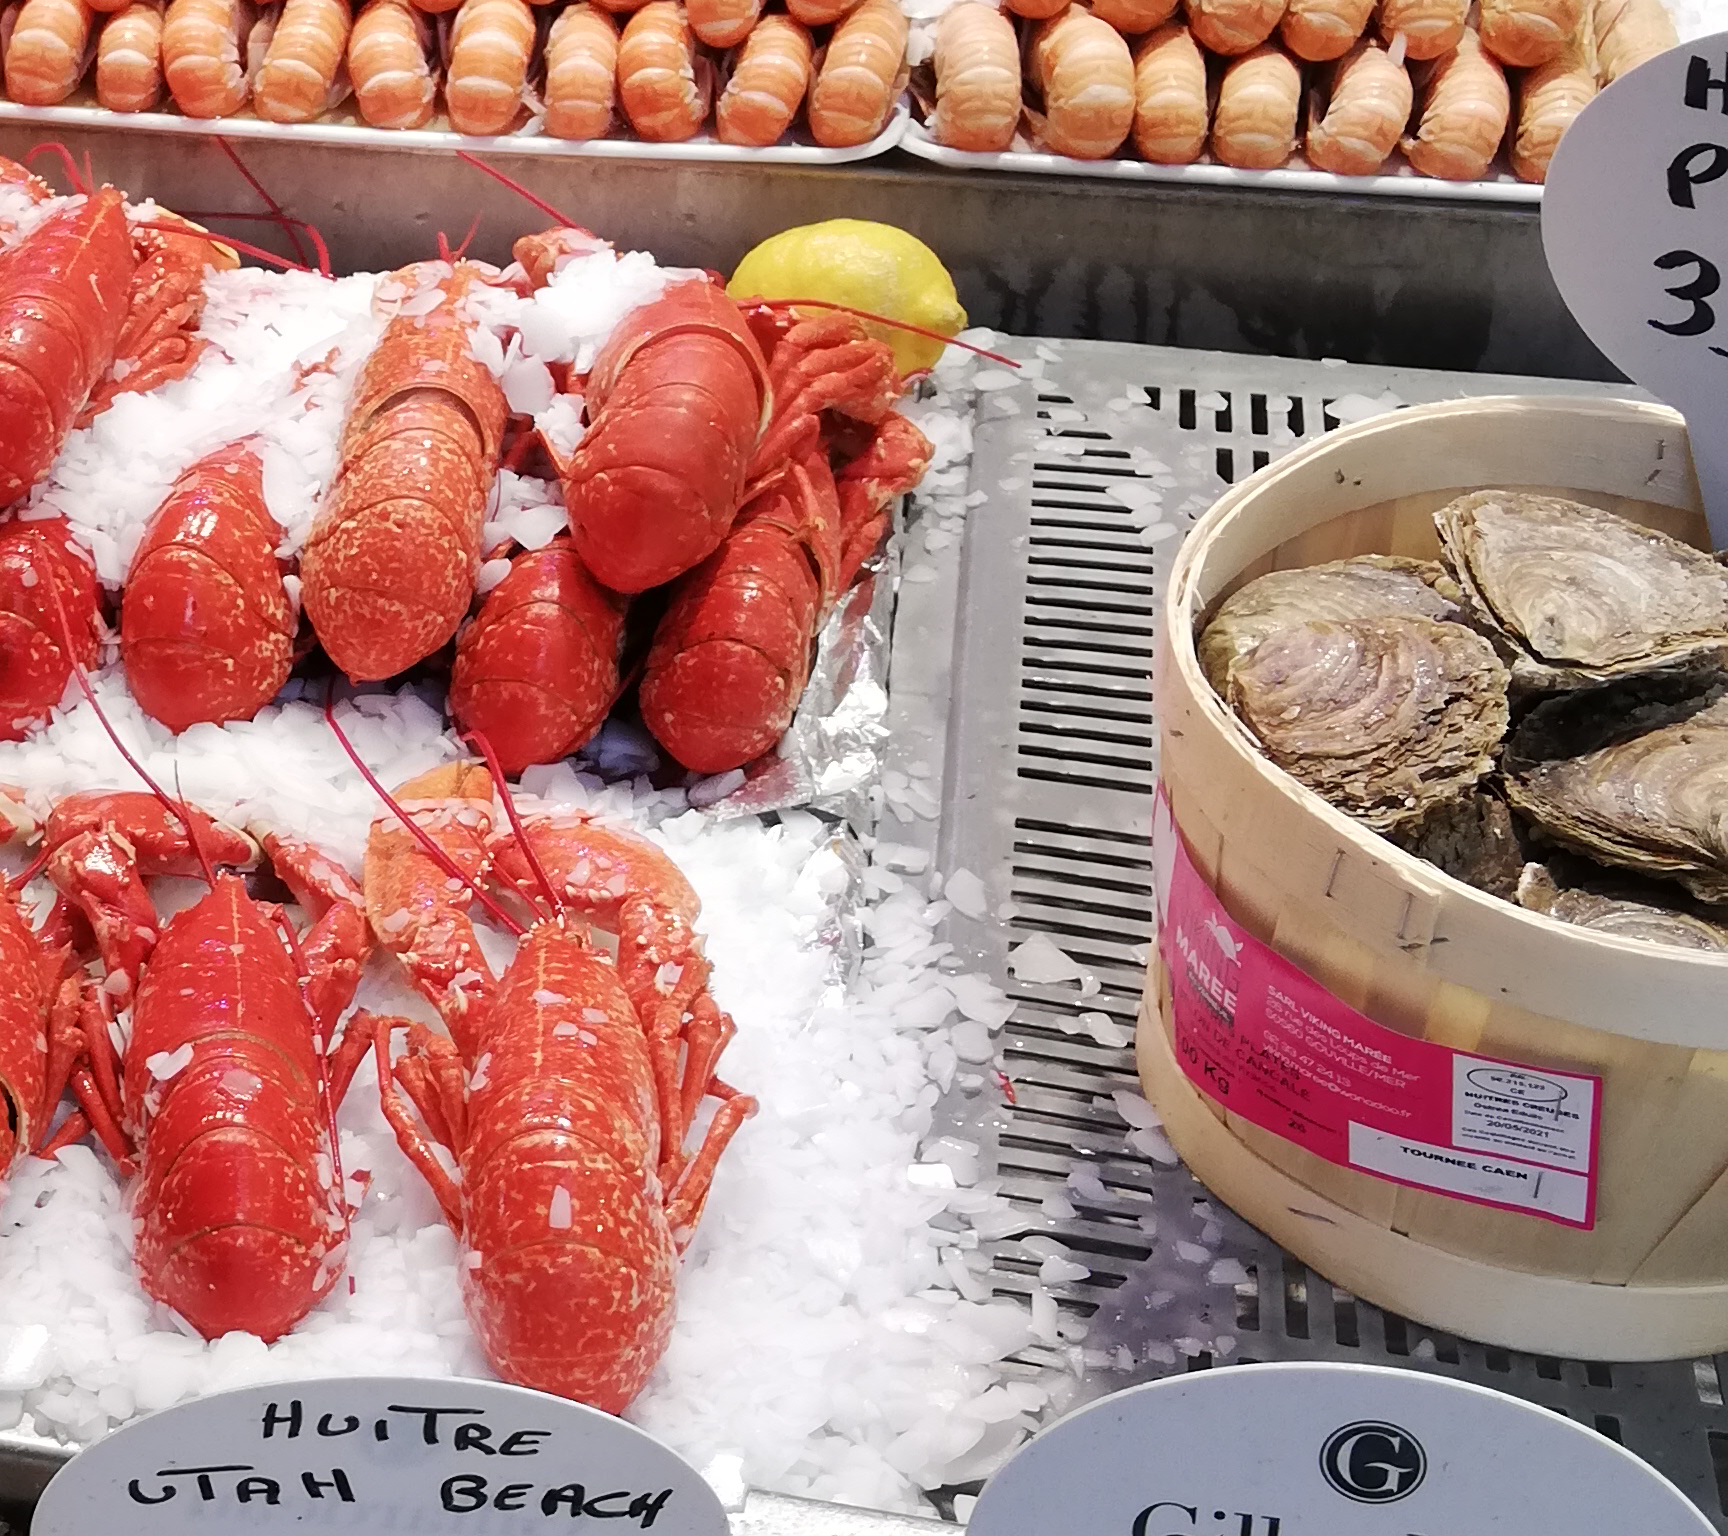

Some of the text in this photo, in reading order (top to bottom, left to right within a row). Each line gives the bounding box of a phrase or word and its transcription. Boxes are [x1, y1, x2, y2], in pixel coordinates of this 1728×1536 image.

[1268, 985, 1298, 1012] SARL
[1301, 1007, 1341, 1039] VIKING
[1486, 1120, 1549, 1139] 20/05/2021
[1399, 1144, 1528, 1181] TOURNEE CAEN
[261, 1399, 552, 1457] HUITRE
[128, 1465, 357, 1505] UTAH
[439, 1474, 673, 1528] BEACH
